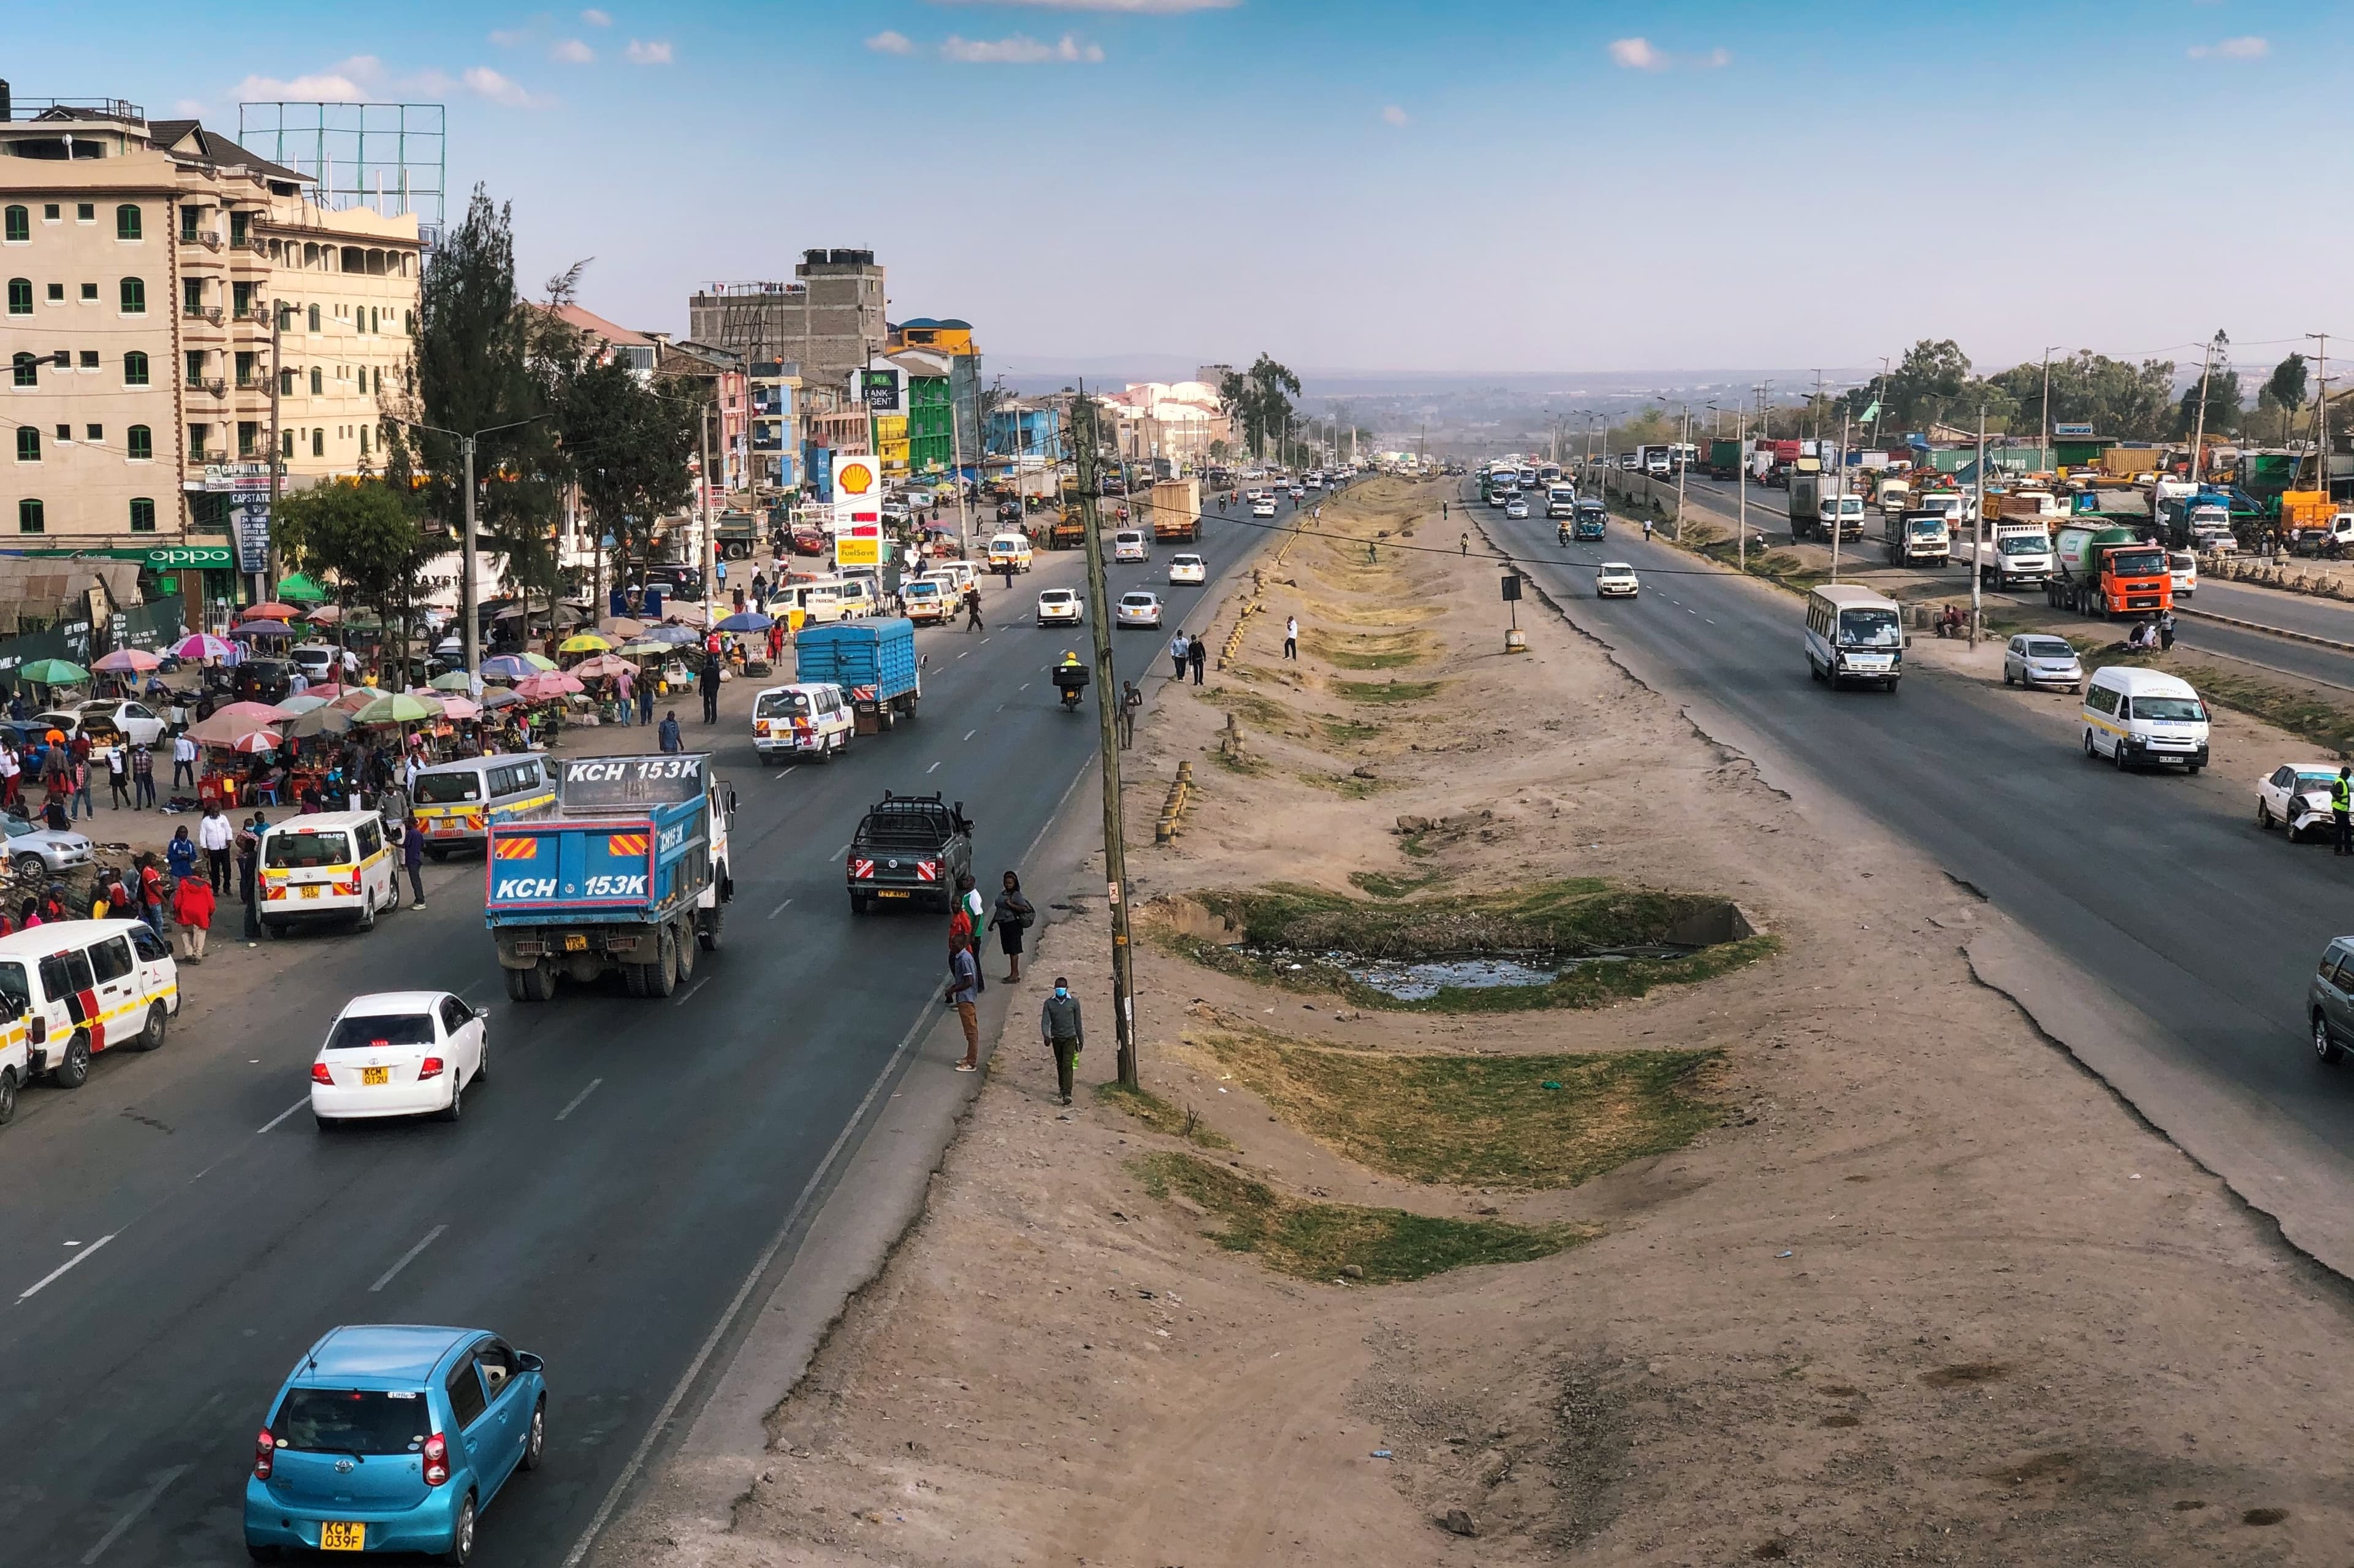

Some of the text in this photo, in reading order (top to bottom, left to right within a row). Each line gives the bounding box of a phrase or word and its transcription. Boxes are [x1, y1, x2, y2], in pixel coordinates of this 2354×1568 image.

[221, 464, 285, 474] CAPHILL HOEL
[567, 761, 701, 782] KCH 153K
[497, 878, 557, 899] KCH
[585, 875, 648, 896] 153K
[326, 1523, 353, 1535] KCW
[326, 1535, 359, 1548] 039F
